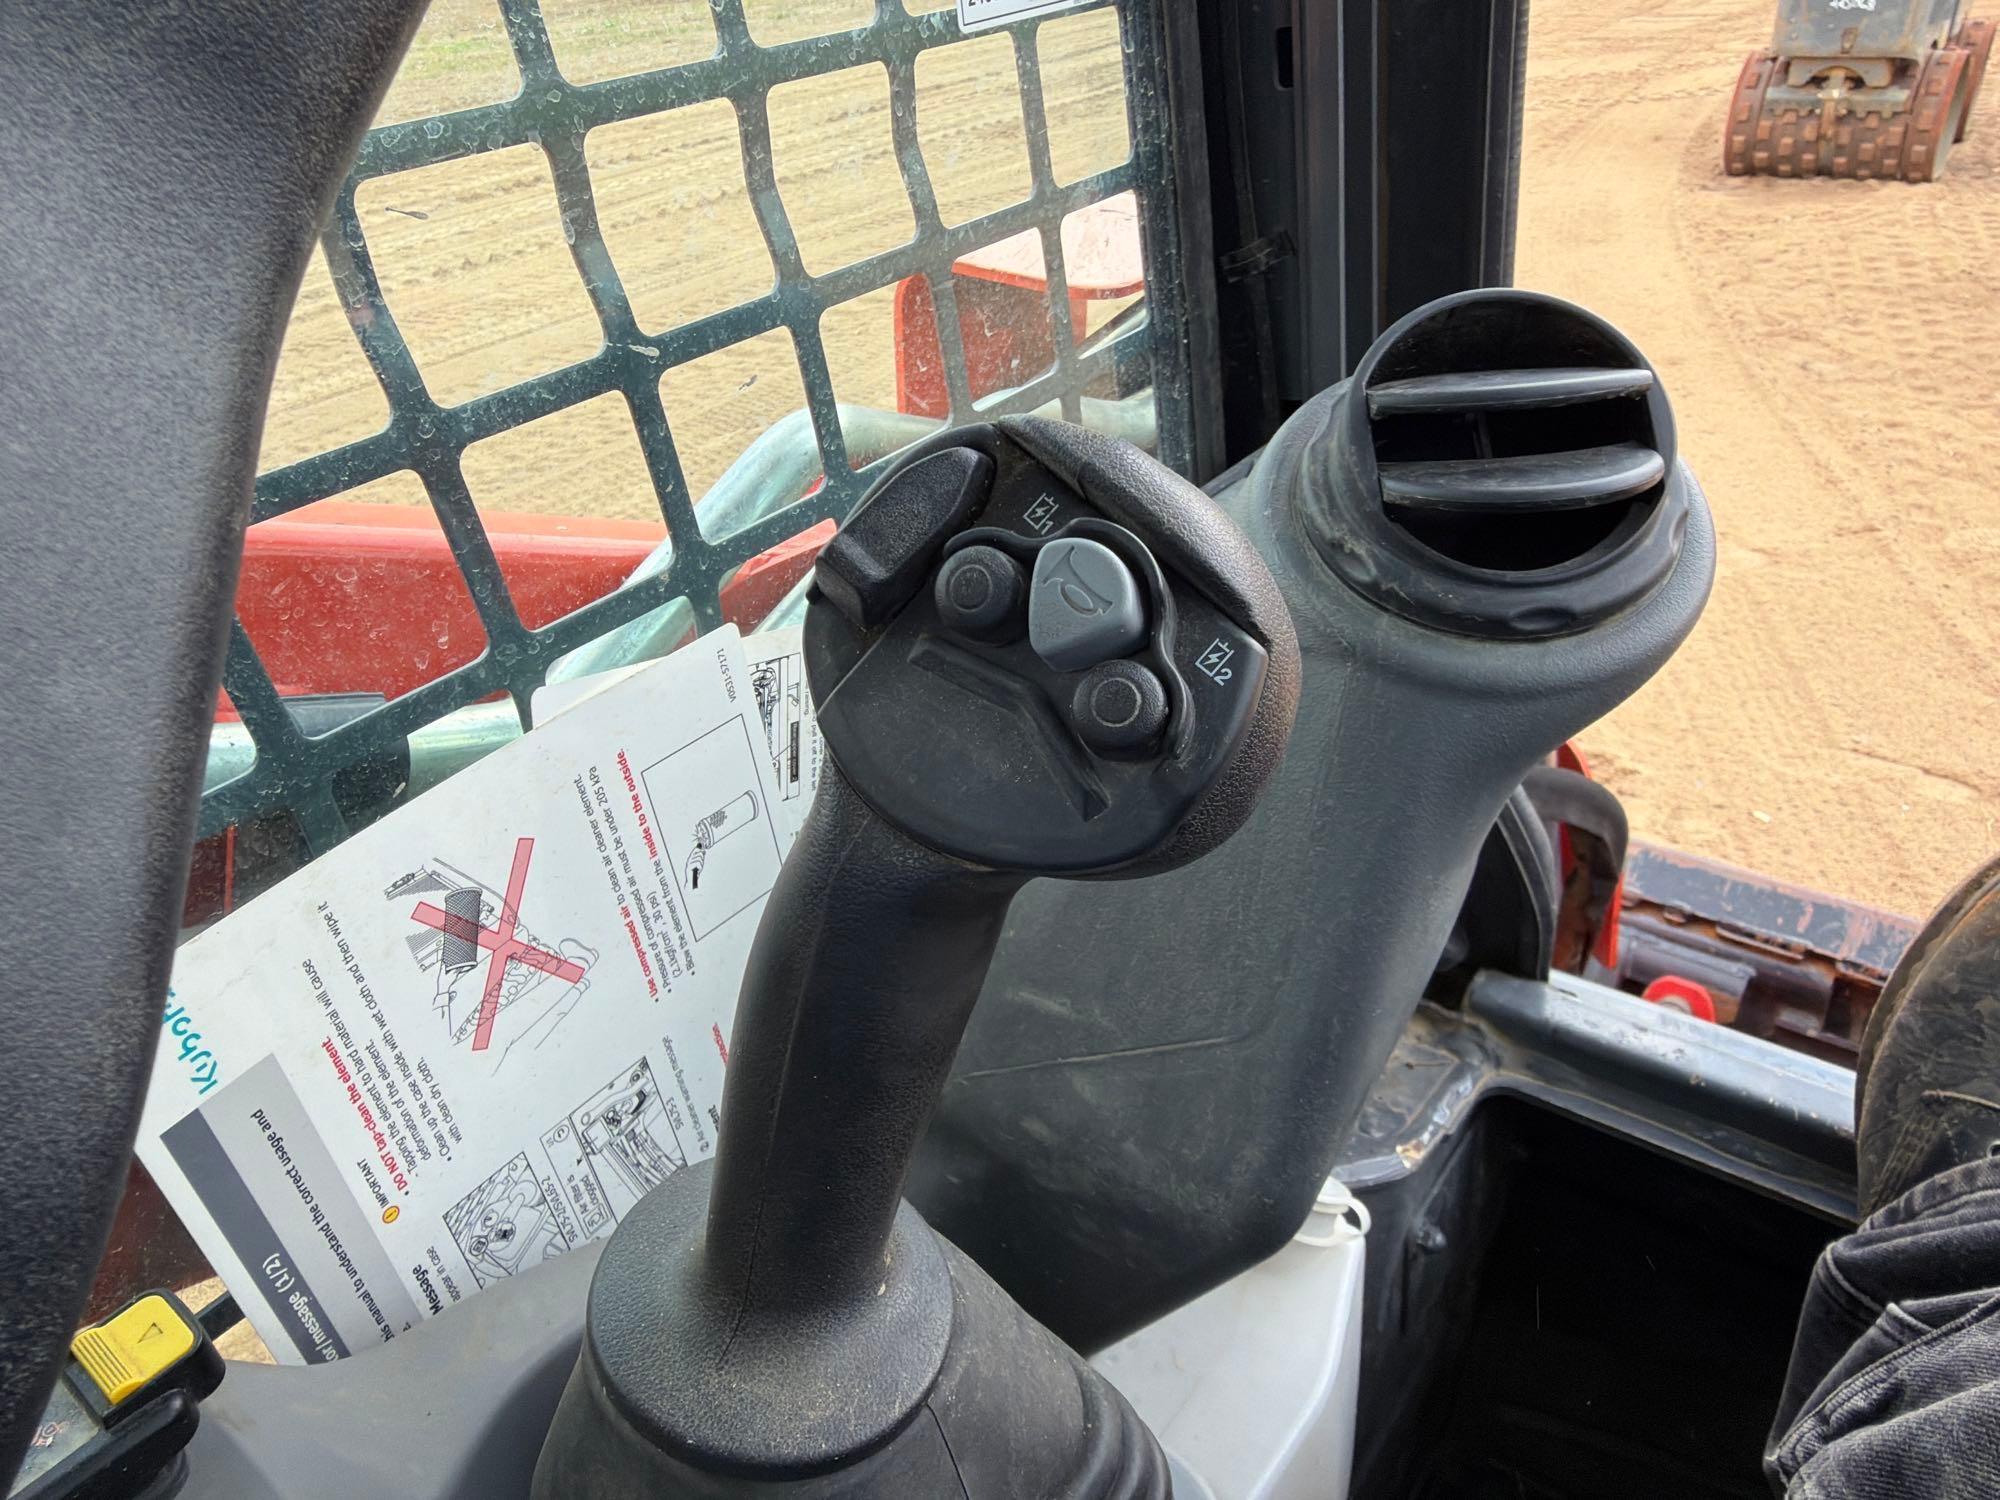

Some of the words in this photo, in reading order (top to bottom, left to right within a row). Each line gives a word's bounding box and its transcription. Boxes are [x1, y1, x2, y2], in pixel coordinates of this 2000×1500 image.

[716, 647, 737, 703] V0531-57171
[1214, 667, 1233, 686] 2
[588, 765, 601, 787] kPa
[616, 748, 636, 793] outside.
[573, 773, 595, 817] element.
[593, 786, 609, 807] 205
[631, 792, 643, 814] the
[602, 807, 619, 836] under
[638, 813, 648, 827] to
[589, 818, 607, 853] cleaner
[613, 835, 624, 852] be
[642, 826, 658, 860] inside
[602, 854, 613, 868] air
[617, 848, 632, 875] must
[653, 858, 664, 877] the
[607, 867, 622, 894] clean
[626, 875, 637, 889] air
[658, 875, 671, 899] from
[316, 900, 329, 912] it
[616, 893, 626, 906] to
[646, 890, 661, 910] psi)
[619, 905, 632, 920] air
[629, 888, 655, 941] compressed
[652, 909, 664, 924] 30
[665, 896, 683, 934] element
[323, 911, 342, 940] wipe
[337, 938, 355, 966] then
[624, 919, 652, 978] compressed
[647, 940, 659, 952] of
[678, 932, 688, 950] the
[654, 950, 672, 989] Pressure
[683, 948, 695, 972] Blow
[302, 958, 323, 991] cause
[346, 963, 366, 985] and
[359, 983, 378, 1010] cloth
[647, 976, 658, 998] Use
[315, 989, 333, 1010] will
[325, 1008, 355, 1050] material
[371, 1009, 388, 1031] wet
[381, 1029, 399, 1053] with
[321, 1035, 352, 1084] element.
[346, 1048, 367, 1076] hard
[364, 1038, 391, 1081] element.
[661, 1035, 680, 1072] message
[393, 1050, 413, 1082] inside
[416, 1056, 434, 1084] cloth.
[361, 1072, 373, 1087] to
[385, 1080, 400, 1100] the
[407, 1079, 424, 1102] case
[428, 1082, 442, 1100] dry
[346, 1082, 362, 1105] the
[366, 1083, 392, 1122] element
[391, 1097, 405, 1109] of
[250, 1108, 272, 1133] and
[418, 1100, 432, 1120] the
[436, 1098, 454, 1124] clean
[357, 1101, 387, 1153] tap-clean
[387, 1120, 401, 1140] the
[400, 1107, 432, 1161] deformation
[426, 1117, 438, 1132] up
[447, 1122, 463, 1145] with
[266, 1131, 292, 1167] usage
[395, 1135, 418, 1175] Tapping
[433, 1129, 451, 1157] Clean
[380, 1151, 399, 1175] NOT
[285, 1164, 314, 1205] correct
[356, 1158, 390, 1209] IMPORTANT
[393, 1172, 408, 1192] DO
[309, 1203, 325, 1226] the
[317, 1222, 358, 1280] understand
[426, 1245, 441, 1267] case
[262, 1252, 295, 1293] (1/2)
[436, 1264, 447, 1278] in
[353, 1277, 365, 1294] to
[412, 1264, 444, 1316] Message
[441, 1273, 462, 1303] appear
[357, 1289, 386, 1326] manual
